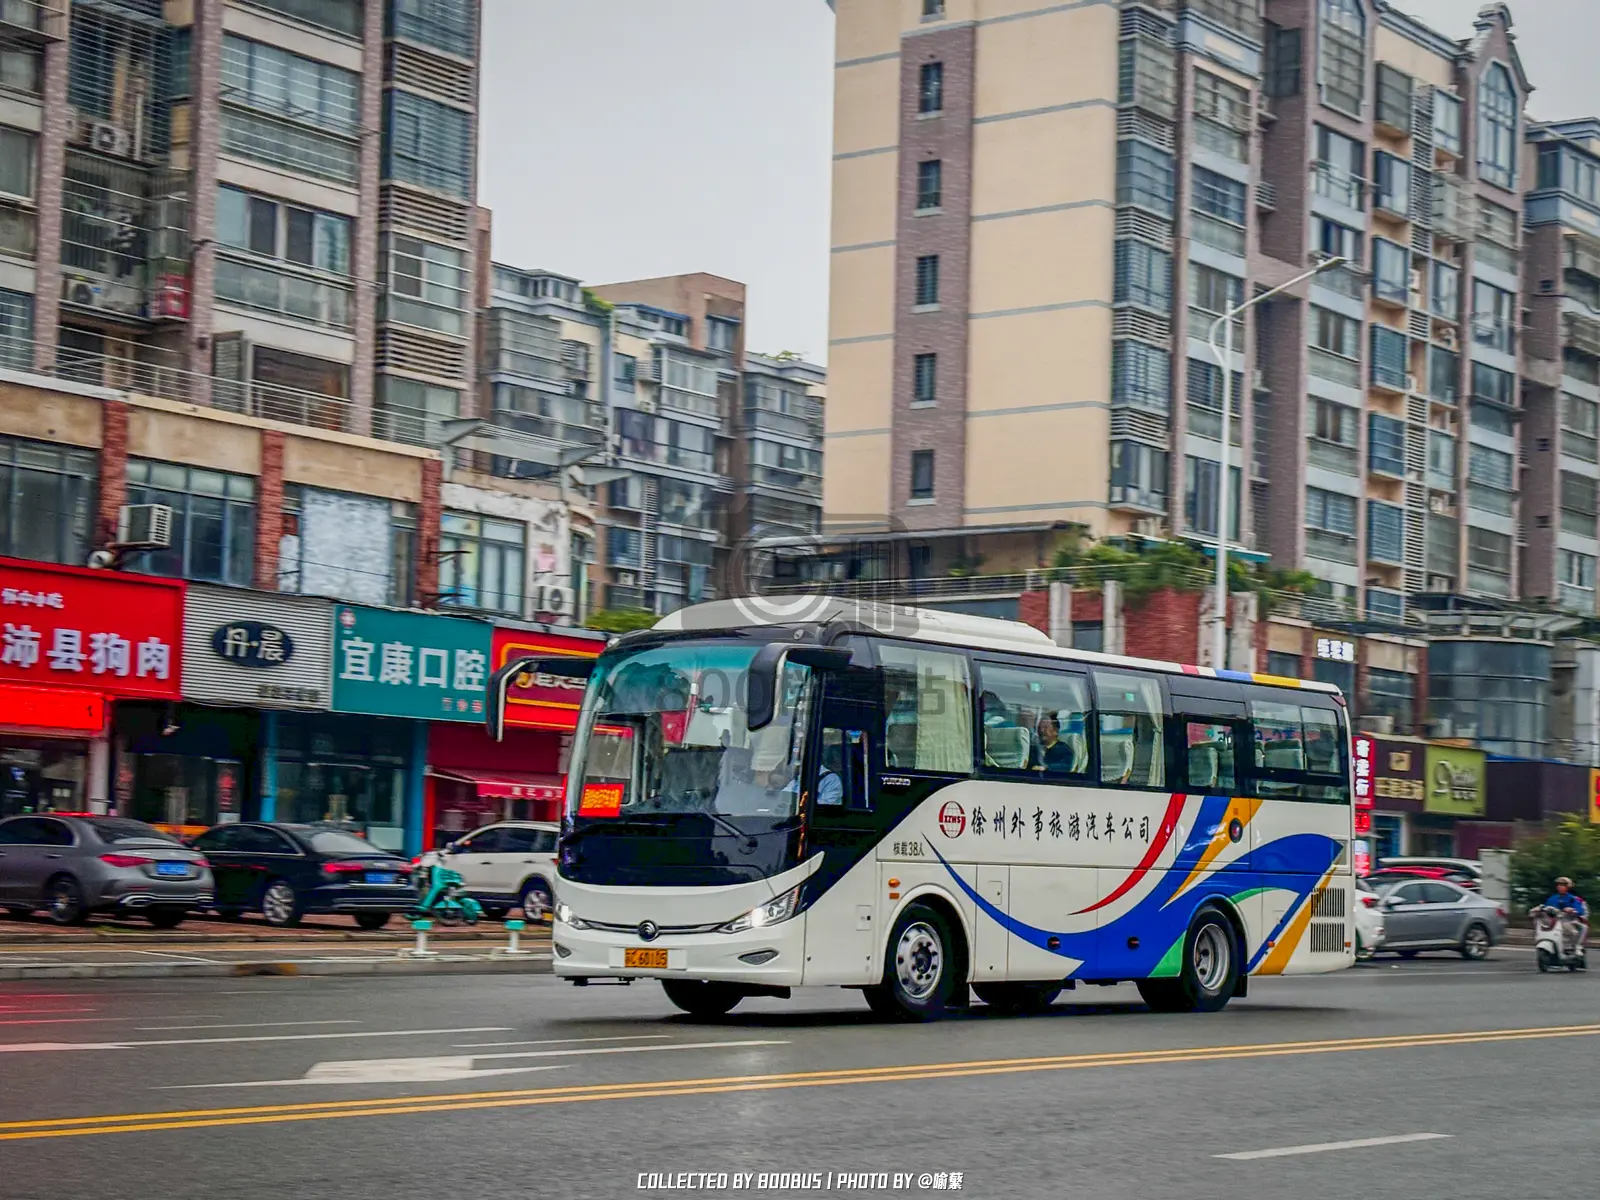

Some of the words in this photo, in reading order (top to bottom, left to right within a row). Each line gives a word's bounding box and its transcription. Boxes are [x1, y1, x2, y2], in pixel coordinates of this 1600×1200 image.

[1, 622, 170, 680] 沛县狗肉
[339, 636, 487, 691] 宜康口腔
[970, 804, 1151, 844] 徐州外事旅游汽车公司
